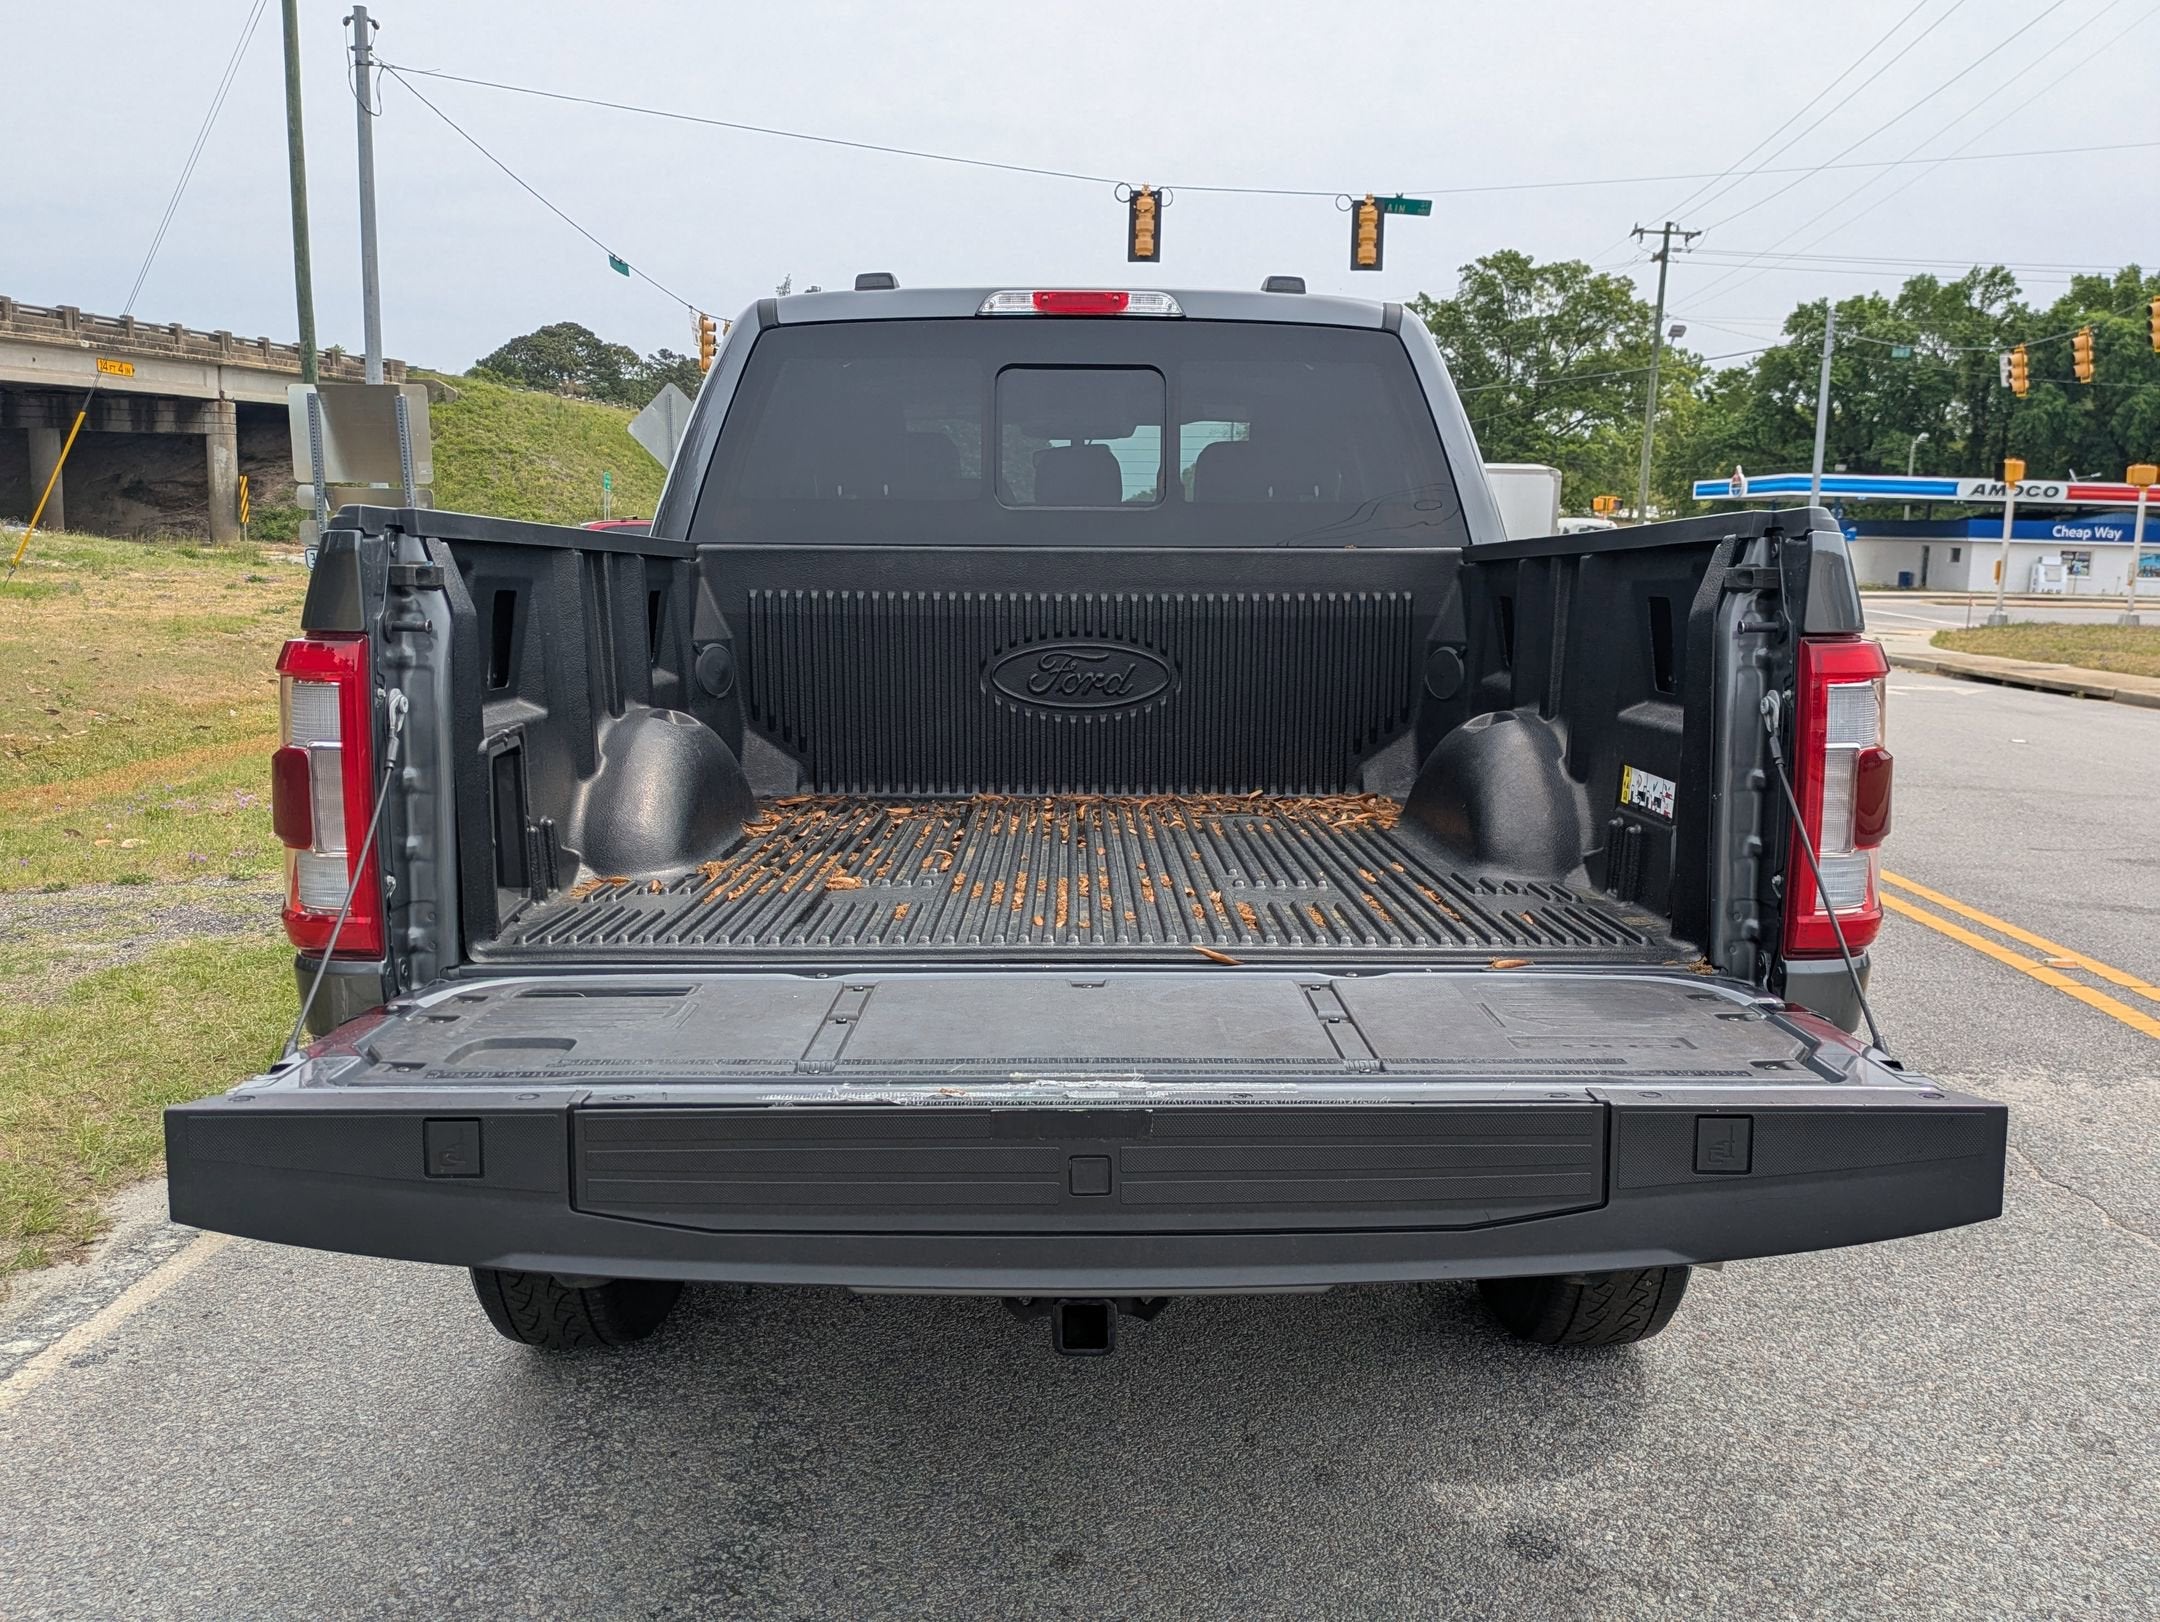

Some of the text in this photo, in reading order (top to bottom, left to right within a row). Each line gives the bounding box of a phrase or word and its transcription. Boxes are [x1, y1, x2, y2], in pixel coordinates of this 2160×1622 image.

[1386, 203, 1406, 214] AIN
[99, 359, 108, 371] 14
[118, 361, 123, 373] 4
[2052, 525, 2123, 542] Cheap Way
[1027, 651, 1136, 695] Ford
